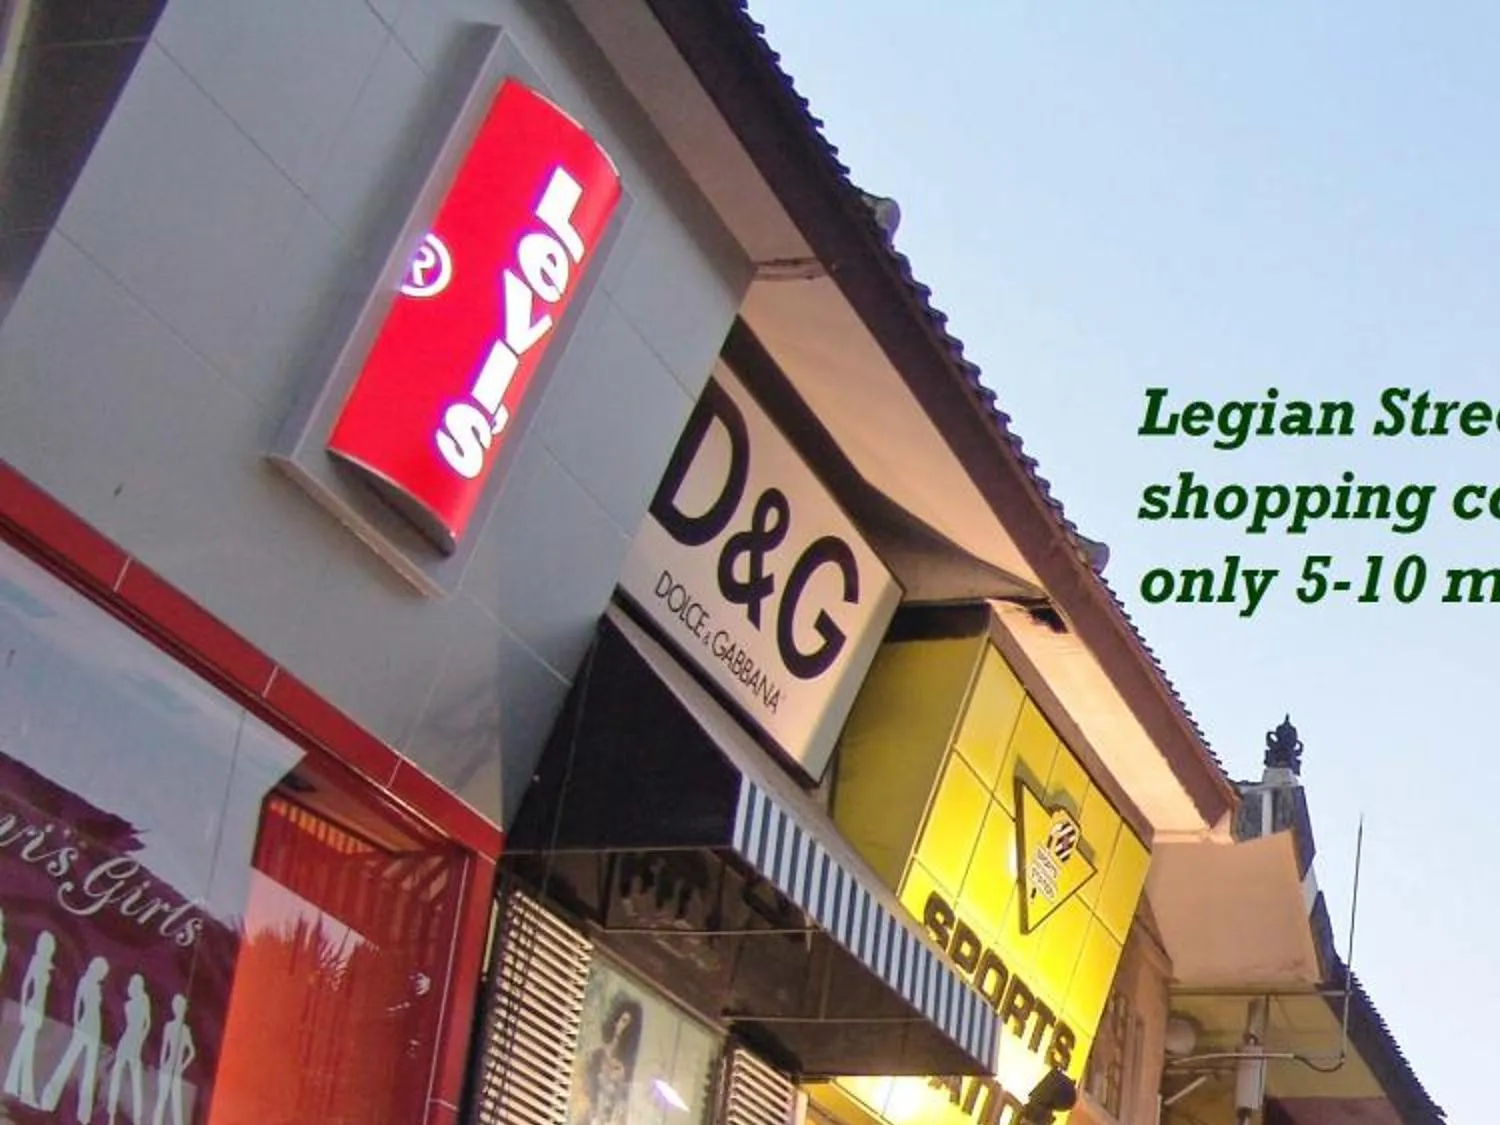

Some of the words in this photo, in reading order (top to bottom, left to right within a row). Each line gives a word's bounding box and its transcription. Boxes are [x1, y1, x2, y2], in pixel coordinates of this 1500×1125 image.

[433, 166, 585, 480] Levi's
[649, 376, 860, 681] D&G
[656, 570, 706, 637] DOLCE
[710, 630, 784, 715] GABBANA
[57, 852, 205, 950] Girls
